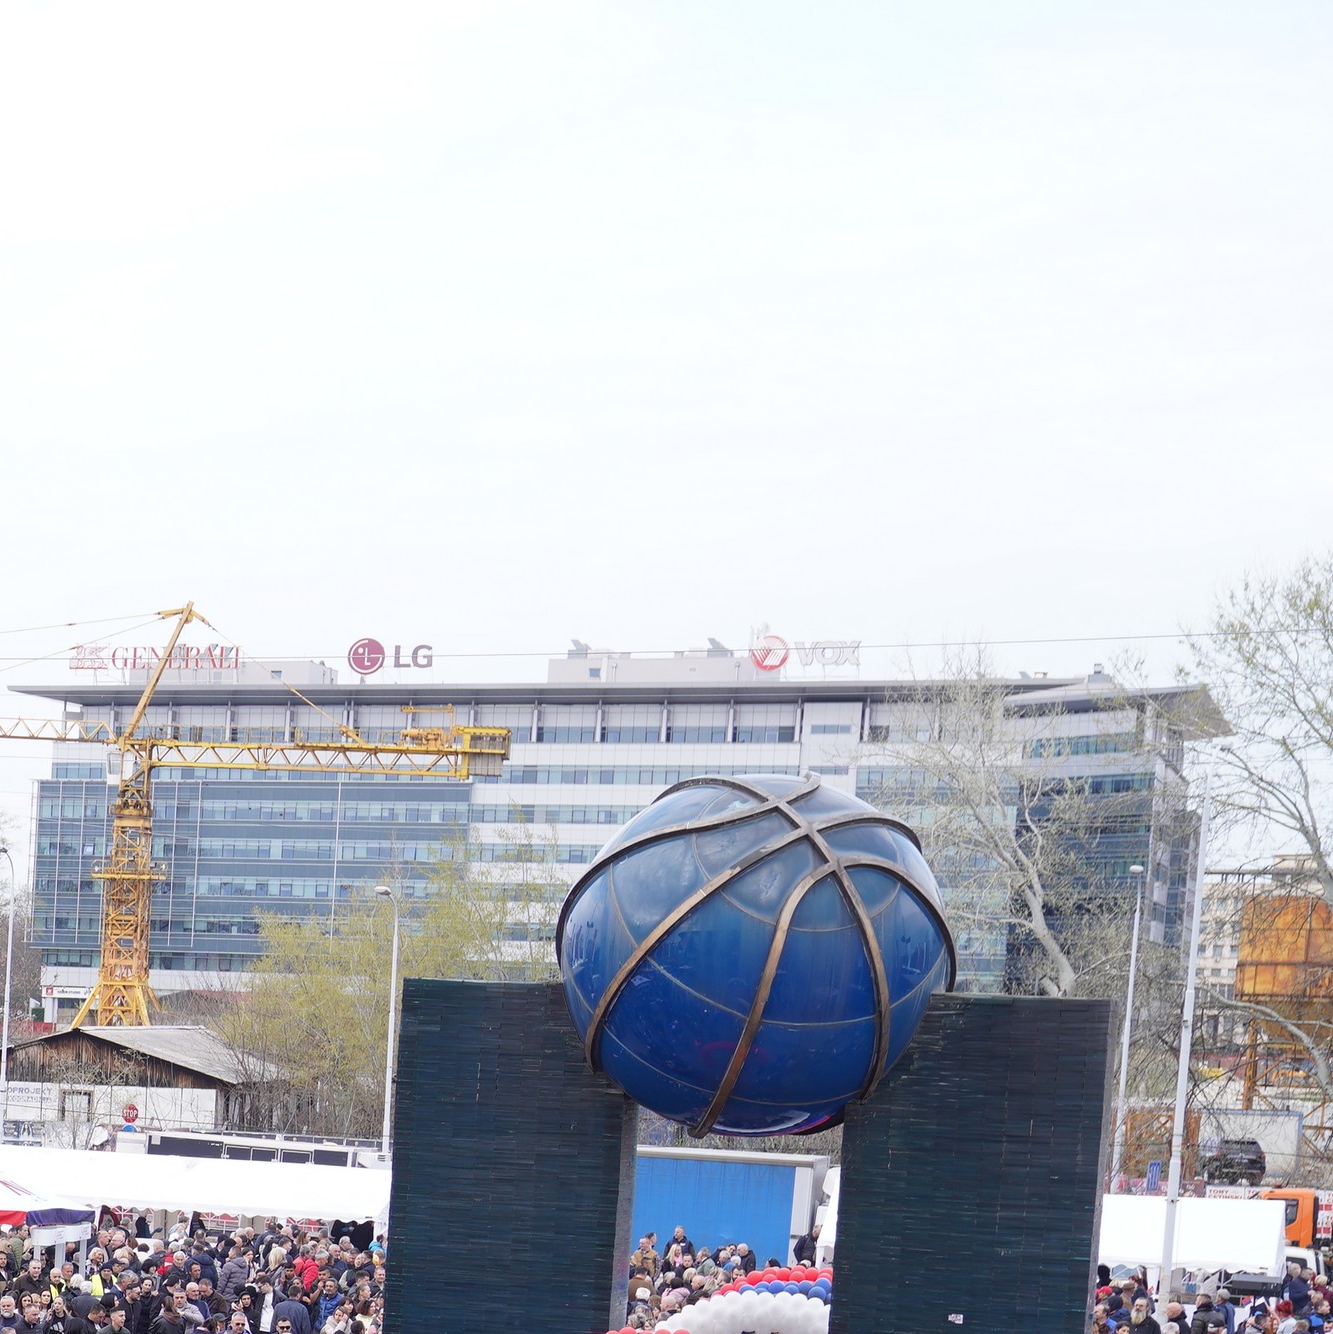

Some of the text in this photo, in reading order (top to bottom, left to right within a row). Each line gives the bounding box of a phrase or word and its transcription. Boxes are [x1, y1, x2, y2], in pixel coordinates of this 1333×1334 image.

[111, 645, 241, 670] GENERALI
[394, 645, 433, 668] LG
[794, 640, 862, 666] VOX
[123, 1109, 138, 1118] STOP
